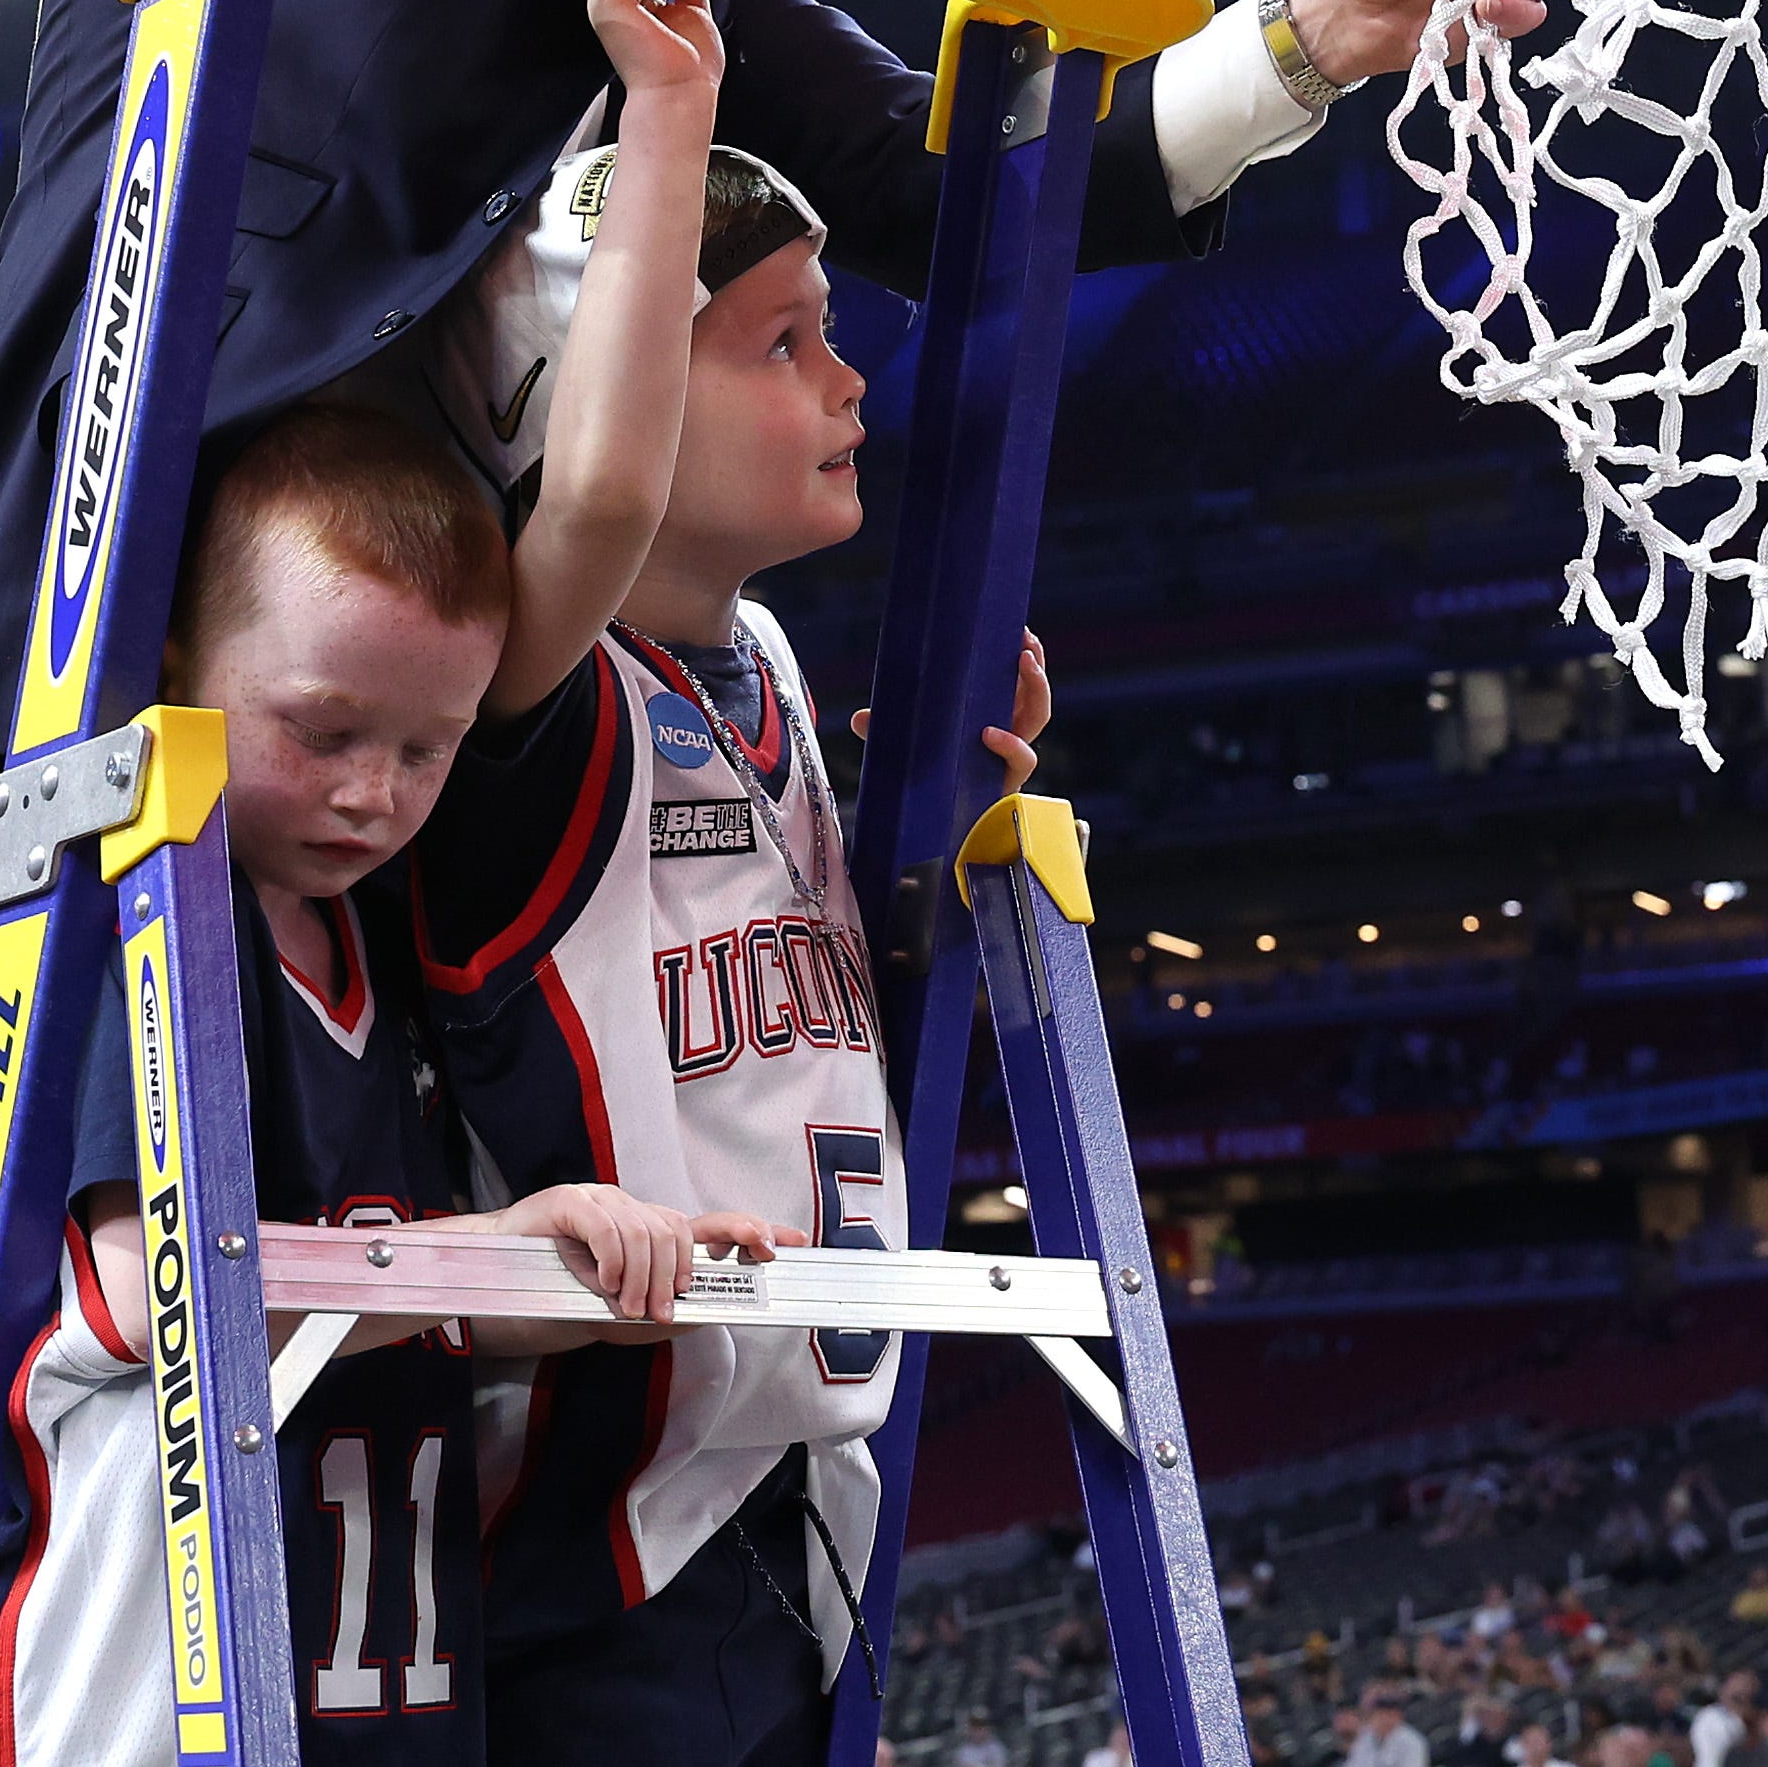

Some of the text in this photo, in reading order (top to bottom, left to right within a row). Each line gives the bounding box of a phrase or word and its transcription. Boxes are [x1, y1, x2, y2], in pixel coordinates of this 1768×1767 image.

[577, 153, 616, 208] NATIONA
[69, 177, 151, 548] WERNER
[656, 723, 712, 752] NCAA
[649, 829, 751, 852] CHANGE
[144, 997, 163, 1134] WERNER
[804, 1123, 894, 1384] 5
[149, 1182, 202, 1526] PODIUM
[180, 1533, 206, 1686] PODIO
[312, 1427, 457, 1717] 11
